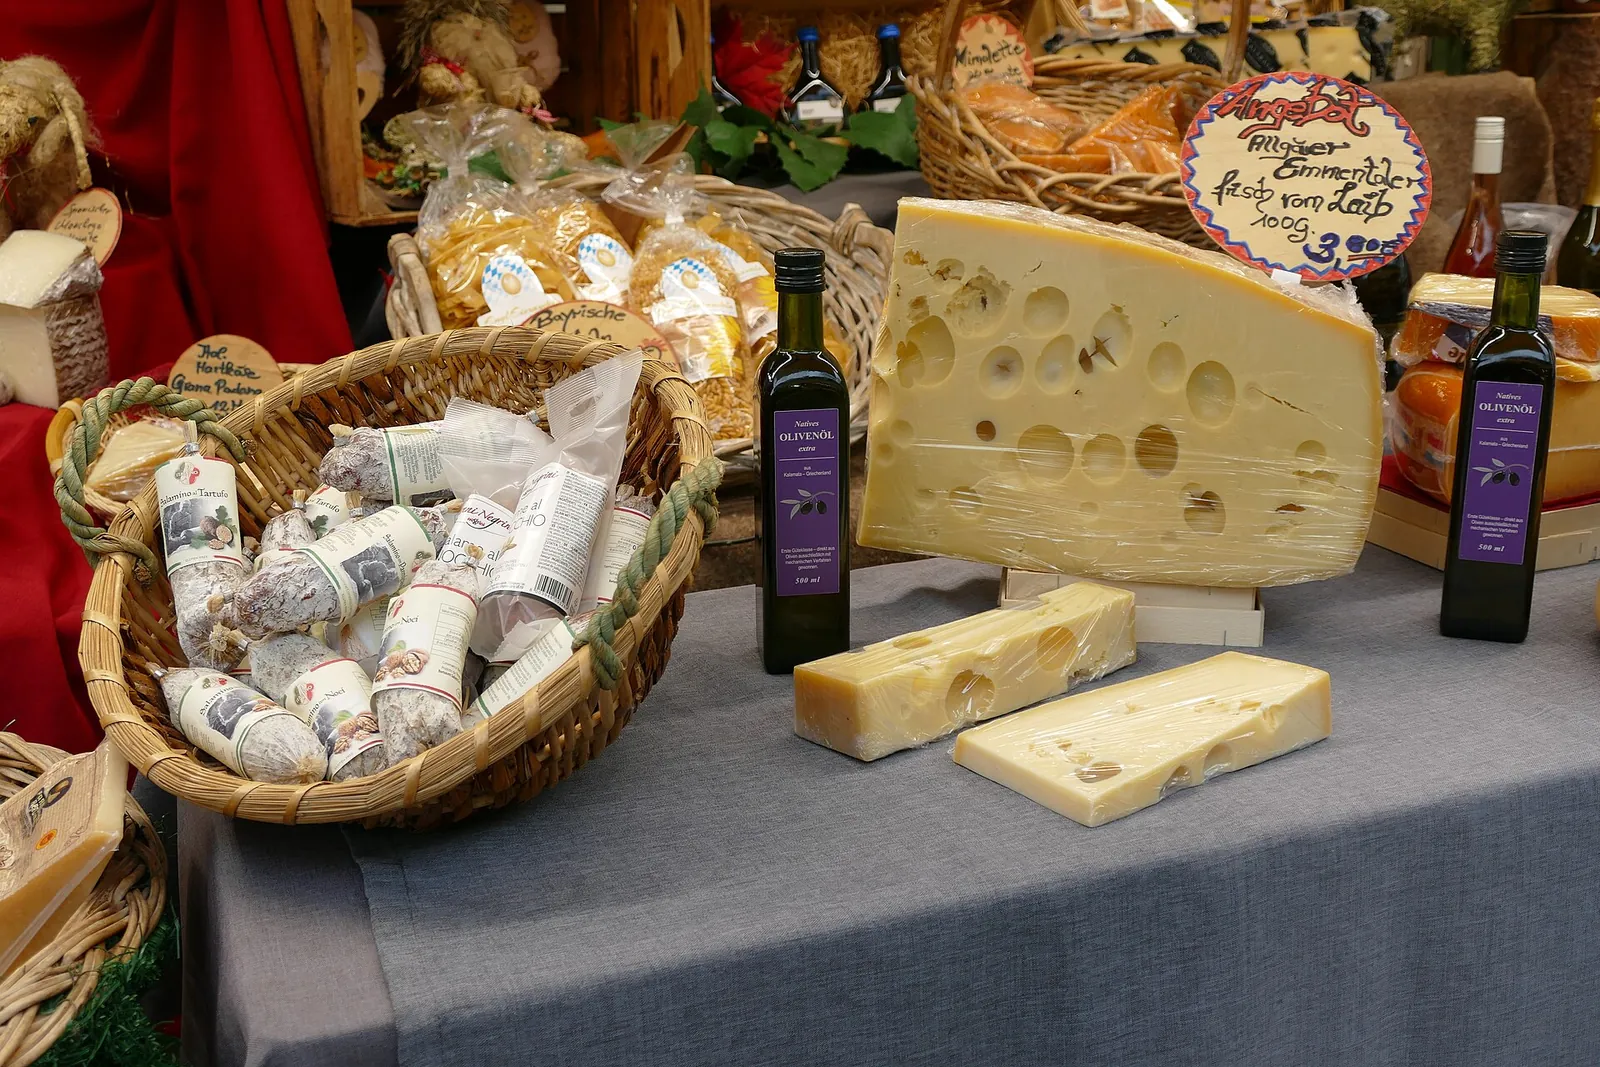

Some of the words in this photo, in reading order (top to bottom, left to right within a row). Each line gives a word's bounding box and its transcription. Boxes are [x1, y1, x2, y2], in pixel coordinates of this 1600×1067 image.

[1214, 78, 1377, 140] Angebot
[1247, 134, 1350, 160] Allgäuer
[1273, 156, 1417, 190] Emmentaler
[1280, 193, 1325, 212] vom
[1328, 182, 1393, 224] Laib
[530, 304, 627, 332] Bayrische
[196, 361, 261, 380] Hartkäse
[171, 374, 212, 395] Grana
[214, 378, 262, 396] Padano
[1496, 392, 1522, 400] Natives
[1479, 402, 1536, 414] OLIVENÖL
[794, 420, 820, 428] Natives
[780, 429, 834, 442] OLIVENÖL
[198, 488, 228, 498] Tartufo
[316, 497, 340, 514] Tartufo
[324, 686, 346, 700] Noci
